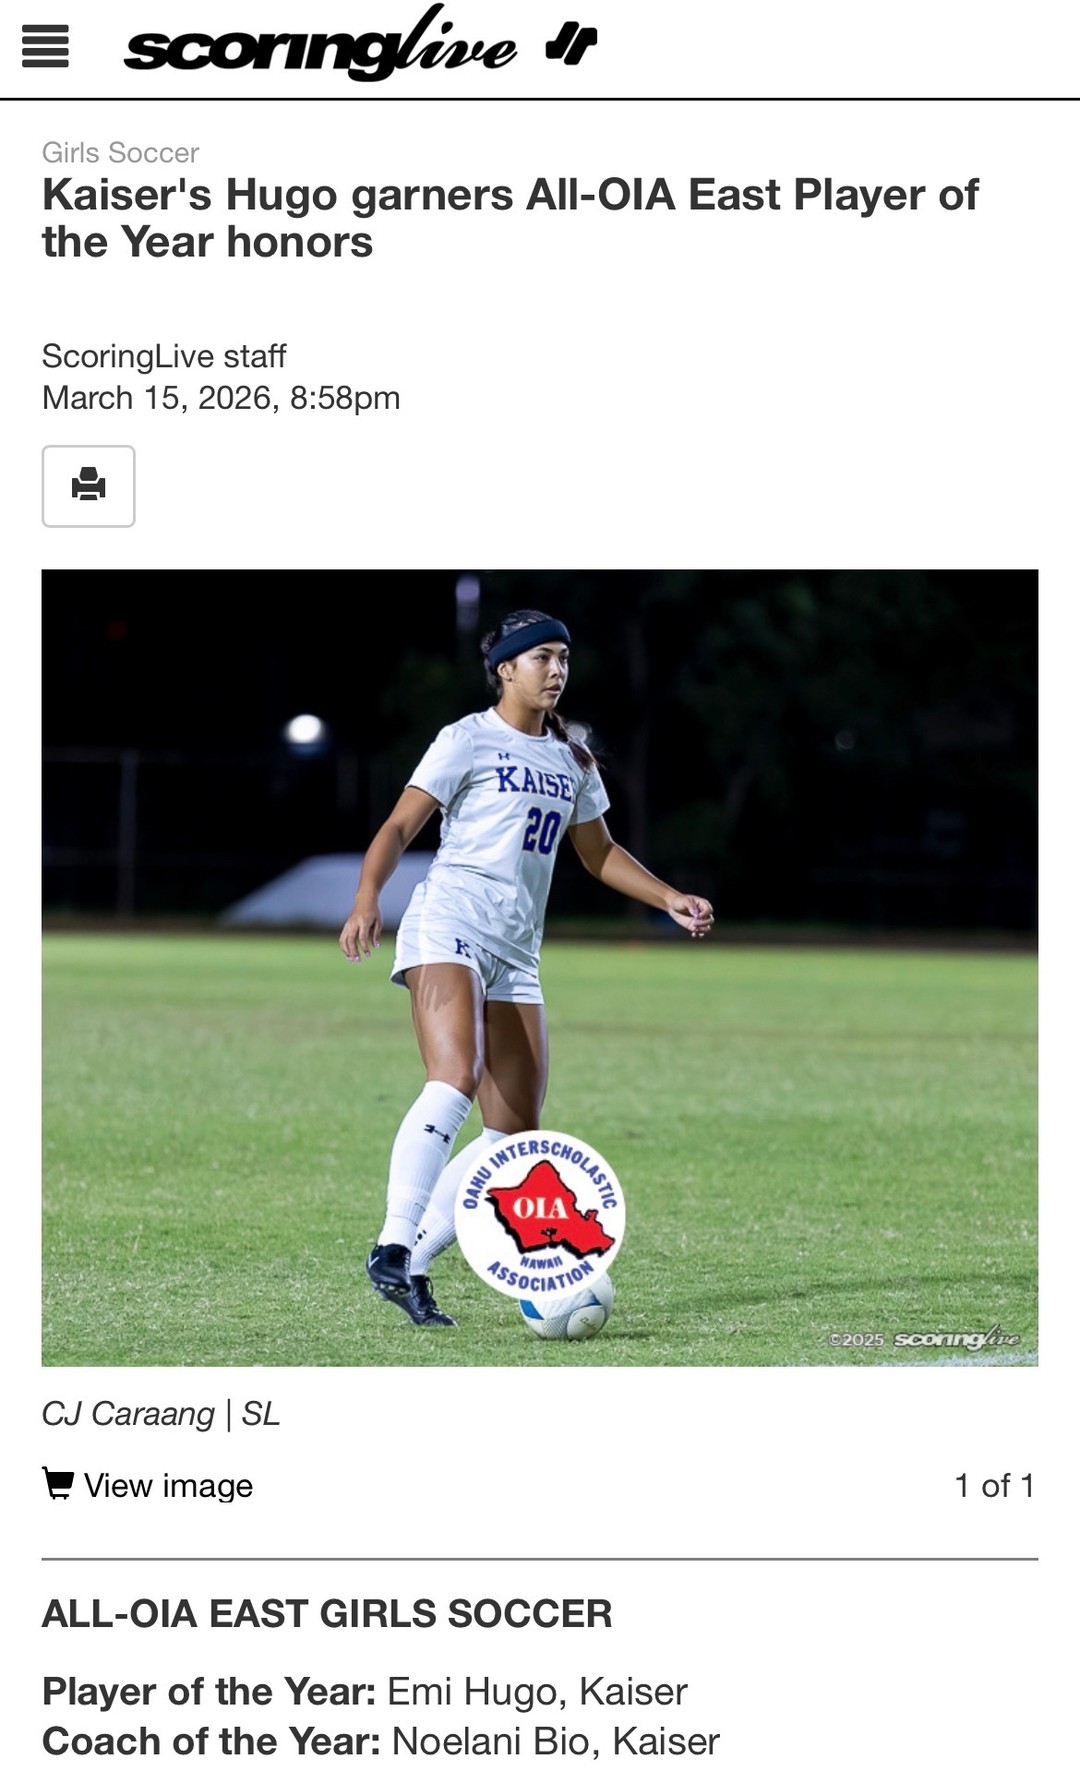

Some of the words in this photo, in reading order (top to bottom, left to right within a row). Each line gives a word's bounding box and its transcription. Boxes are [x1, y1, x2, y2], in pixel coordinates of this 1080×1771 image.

[43, 141, 99, 163] Girls
[109, 142, 199, 163] Soccer
[44, 178, 211, 210] Kaiser's
[228, 178, 337, 218] Hugo
[352, 186, 513, 218] garners
[526, 177, 676, 210] All-OIA
[690, 178, 780, 210] East
[796, 178, 926, 218] Player
[939, 178, 980, 210] of
[42, 225, 107, 257] the
[121, 225, 214, 257] Year
[228, 225, 372, 257] honors
[43, 343, 214, 374] ScoringLive
[224, 343, 287, 368] staff
[44, 385, 132, 409] March
[146, 385, 187, 414] 15,
[199, 385, 278, 414] 2026,
[291, 385, 399, 415] 8:58pm
[496, 766, 577, 804] KAISE
[523, 807, 561, 855] 20
[455, 938, 472, 958] K
[43, 1400, 82, 1426] CJ
[92, 1400, 215, 1432] Caraang
[242, 1401, 280, 1426] SL
[84, 1473, 153, 1497] View
[164, 1473, 253, 1503] image
[956, 1473, 966, 1497] 1
[982, 1473, 1011, 1497] of
[1022, 1473, 1032, 1497] 1
[41, 1598, 198, 1628] ALL-OIA
[211, 1598, 309, 1628] EAST
[321, 1598, 436, 1628] GIRLS
[449, 1598, 612, 1628] SOCCER
[44, 1677, 156, 1712] Player
[168, 1677, 204, 1705] of
[215, 1677, 272, 1705] the
[284, 1677, 374, 1705] Year:
[389, 1677, 450, 1705] Emi
[466, 1677, 565, 1713] Hugo,
[581, 1677, 688, 1705] Kaiser
[43, 1726, 160, 1755] Coach
[173, 1727, 209, 1755] of
[219, 1727, 277, 1755] the
[289, 1727, 379, 1755] Year:
[394, 1726, 520, 1755] Noelani
[535, 1727, 598, 1760] Bio,
[615, 1727, 720, 1755] Kaiser
